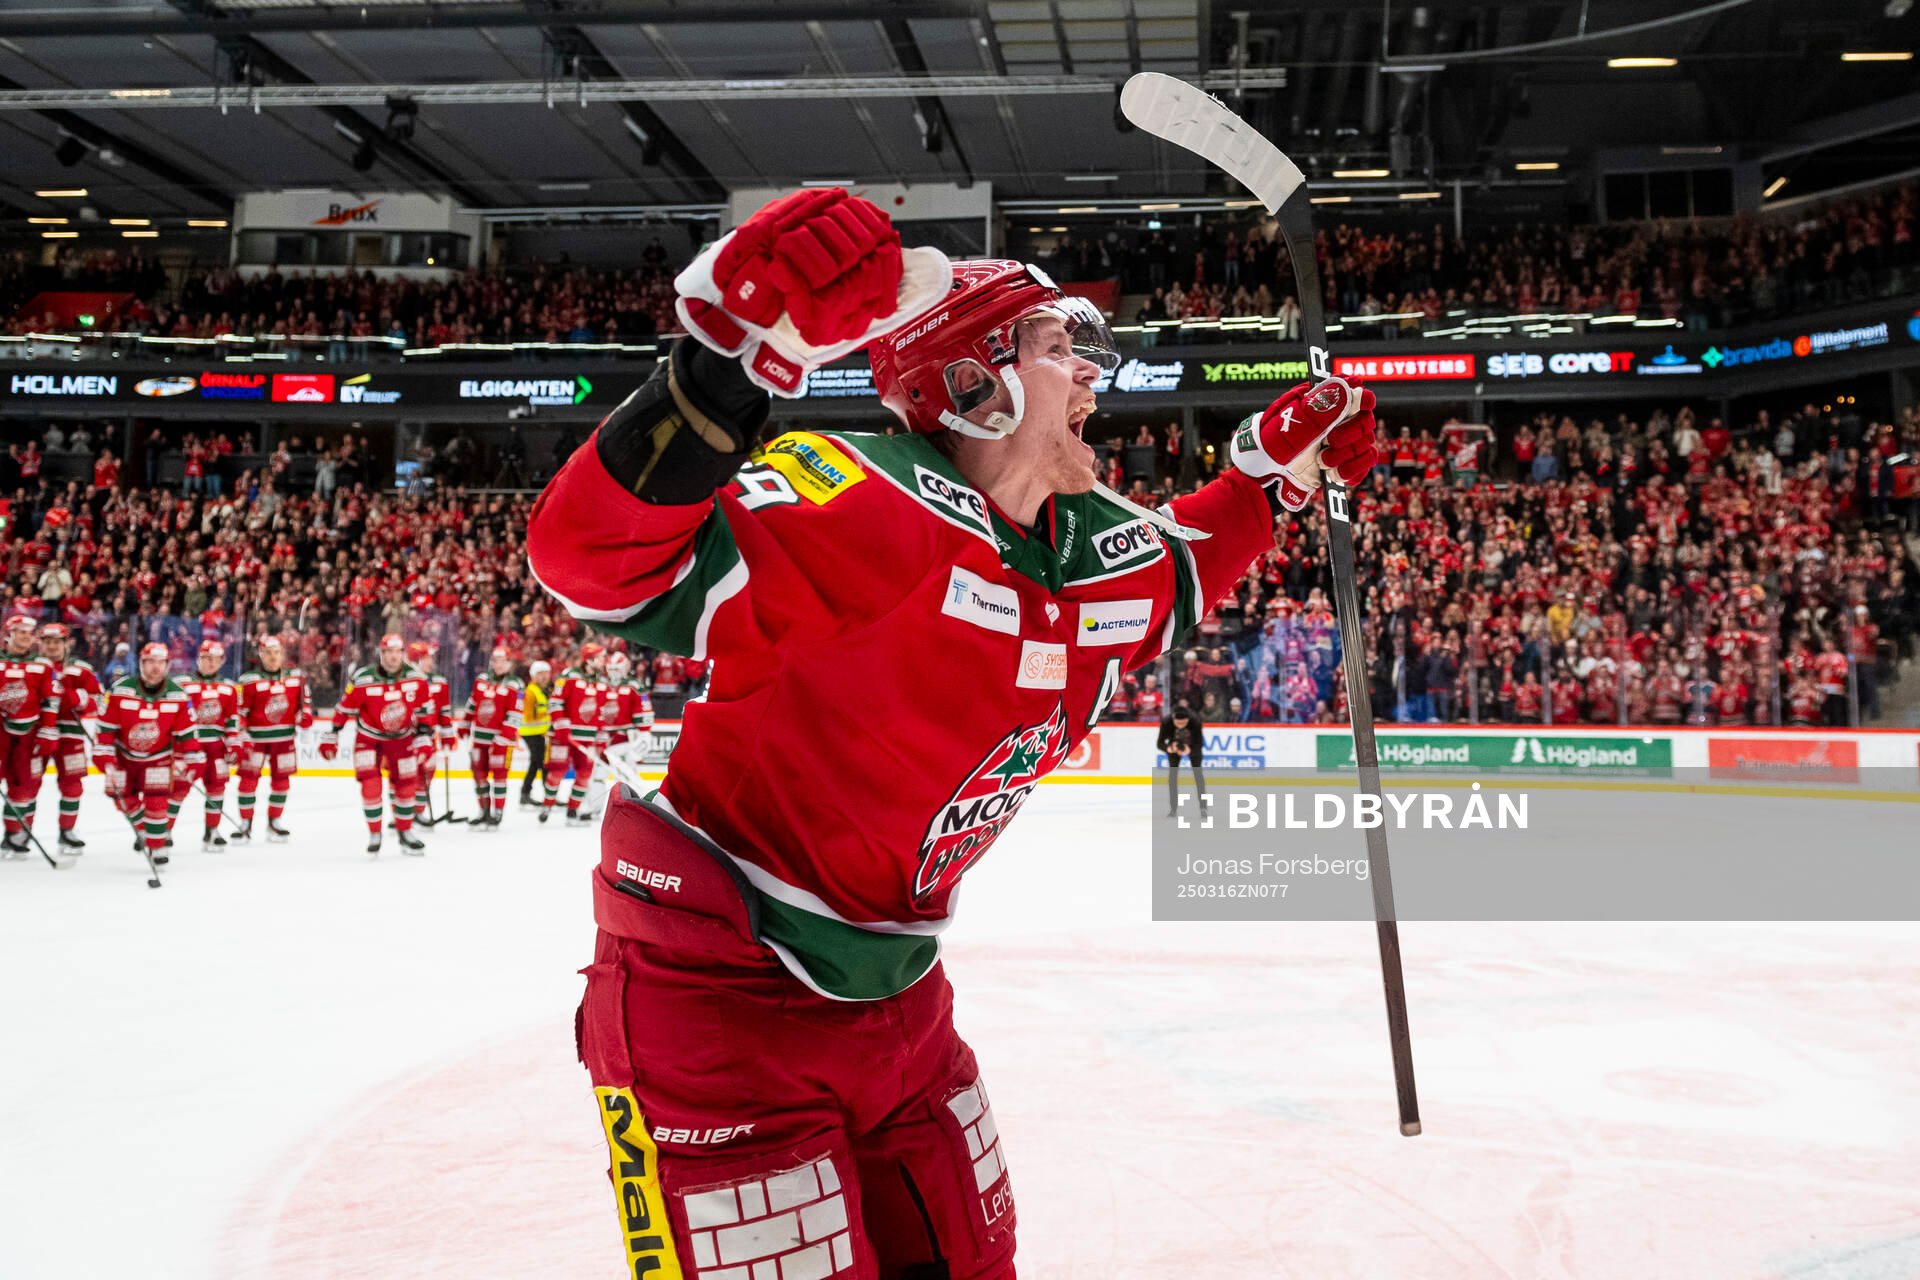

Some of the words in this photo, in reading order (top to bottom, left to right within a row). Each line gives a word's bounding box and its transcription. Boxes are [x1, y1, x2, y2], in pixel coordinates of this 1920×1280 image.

[896, 311, 950, 351] BAUER
[990, 347, 1016, 364] BAUER
[1722, 337, 1793, 367] bravida
[1342, 362, 1376, 375] BAE
[1383, 360, 1466, 374] SYSTEMS
[1487, 354, 1544, 376] SEB
[11, 375, 117, 395] HOLMEN
[460, 380, 575, 397] ELGIGANTEN
[796, 443, 847, 483] MELINS
[736, 460, 801, 512] 9
[1062, 509, 1077, 559] BAUER
[971, 591, 1017, 617] Thermion
[1101, 618, 1148, 630] ACTEMIUM
[1383, 744, 1470, 765] Högland
[1547, 745, 1637, 767] Högland
[616, 859, 682, 894] BAUER
[652, 1123, 756, 1146] BAUER
